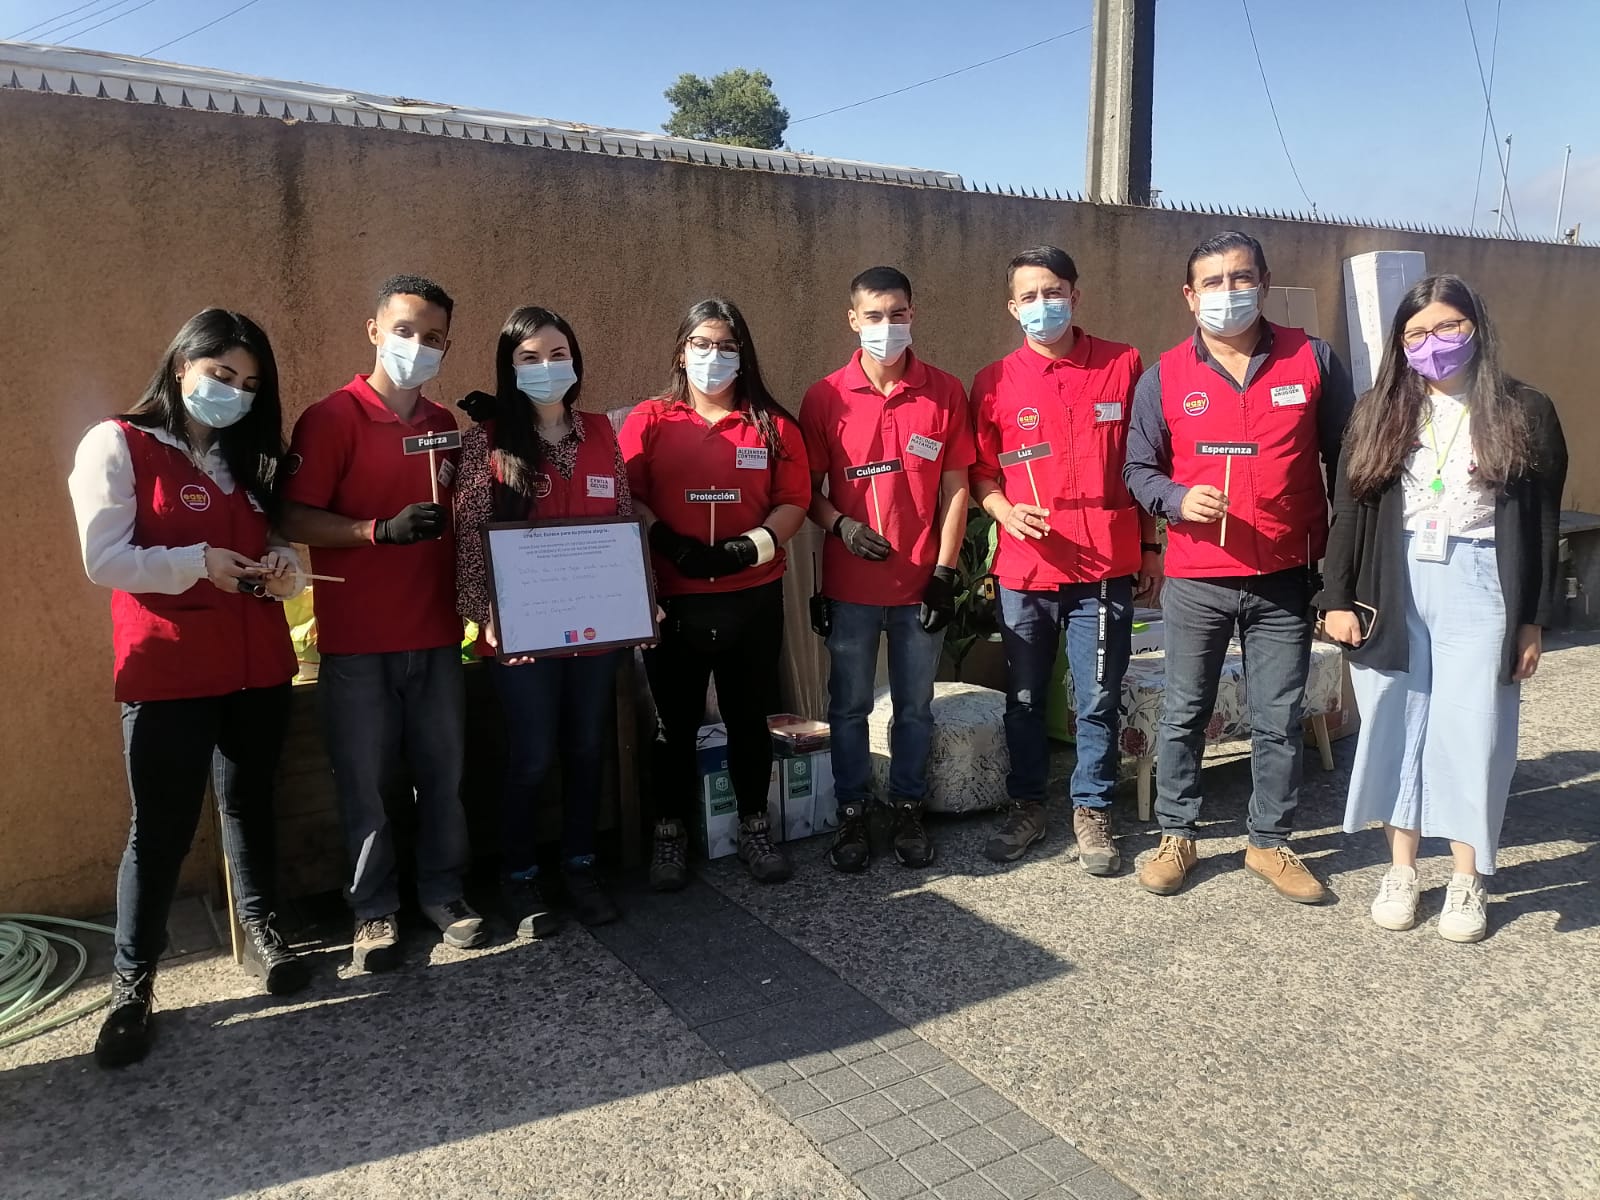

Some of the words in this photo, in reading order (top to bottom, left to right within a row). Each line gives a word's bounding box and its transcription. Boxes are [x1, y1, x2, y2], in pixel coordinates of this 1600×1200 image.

[1186, 399, 1206, 409] easy
[418, 436, 447, 447] Fuerza
[1017, 449, 1033, 458] Luz
[1201, 445, 1252, 456] Esperanza
[856, 464, 892, 477] Cuidado
[690, 492, 735, 501] Protección
